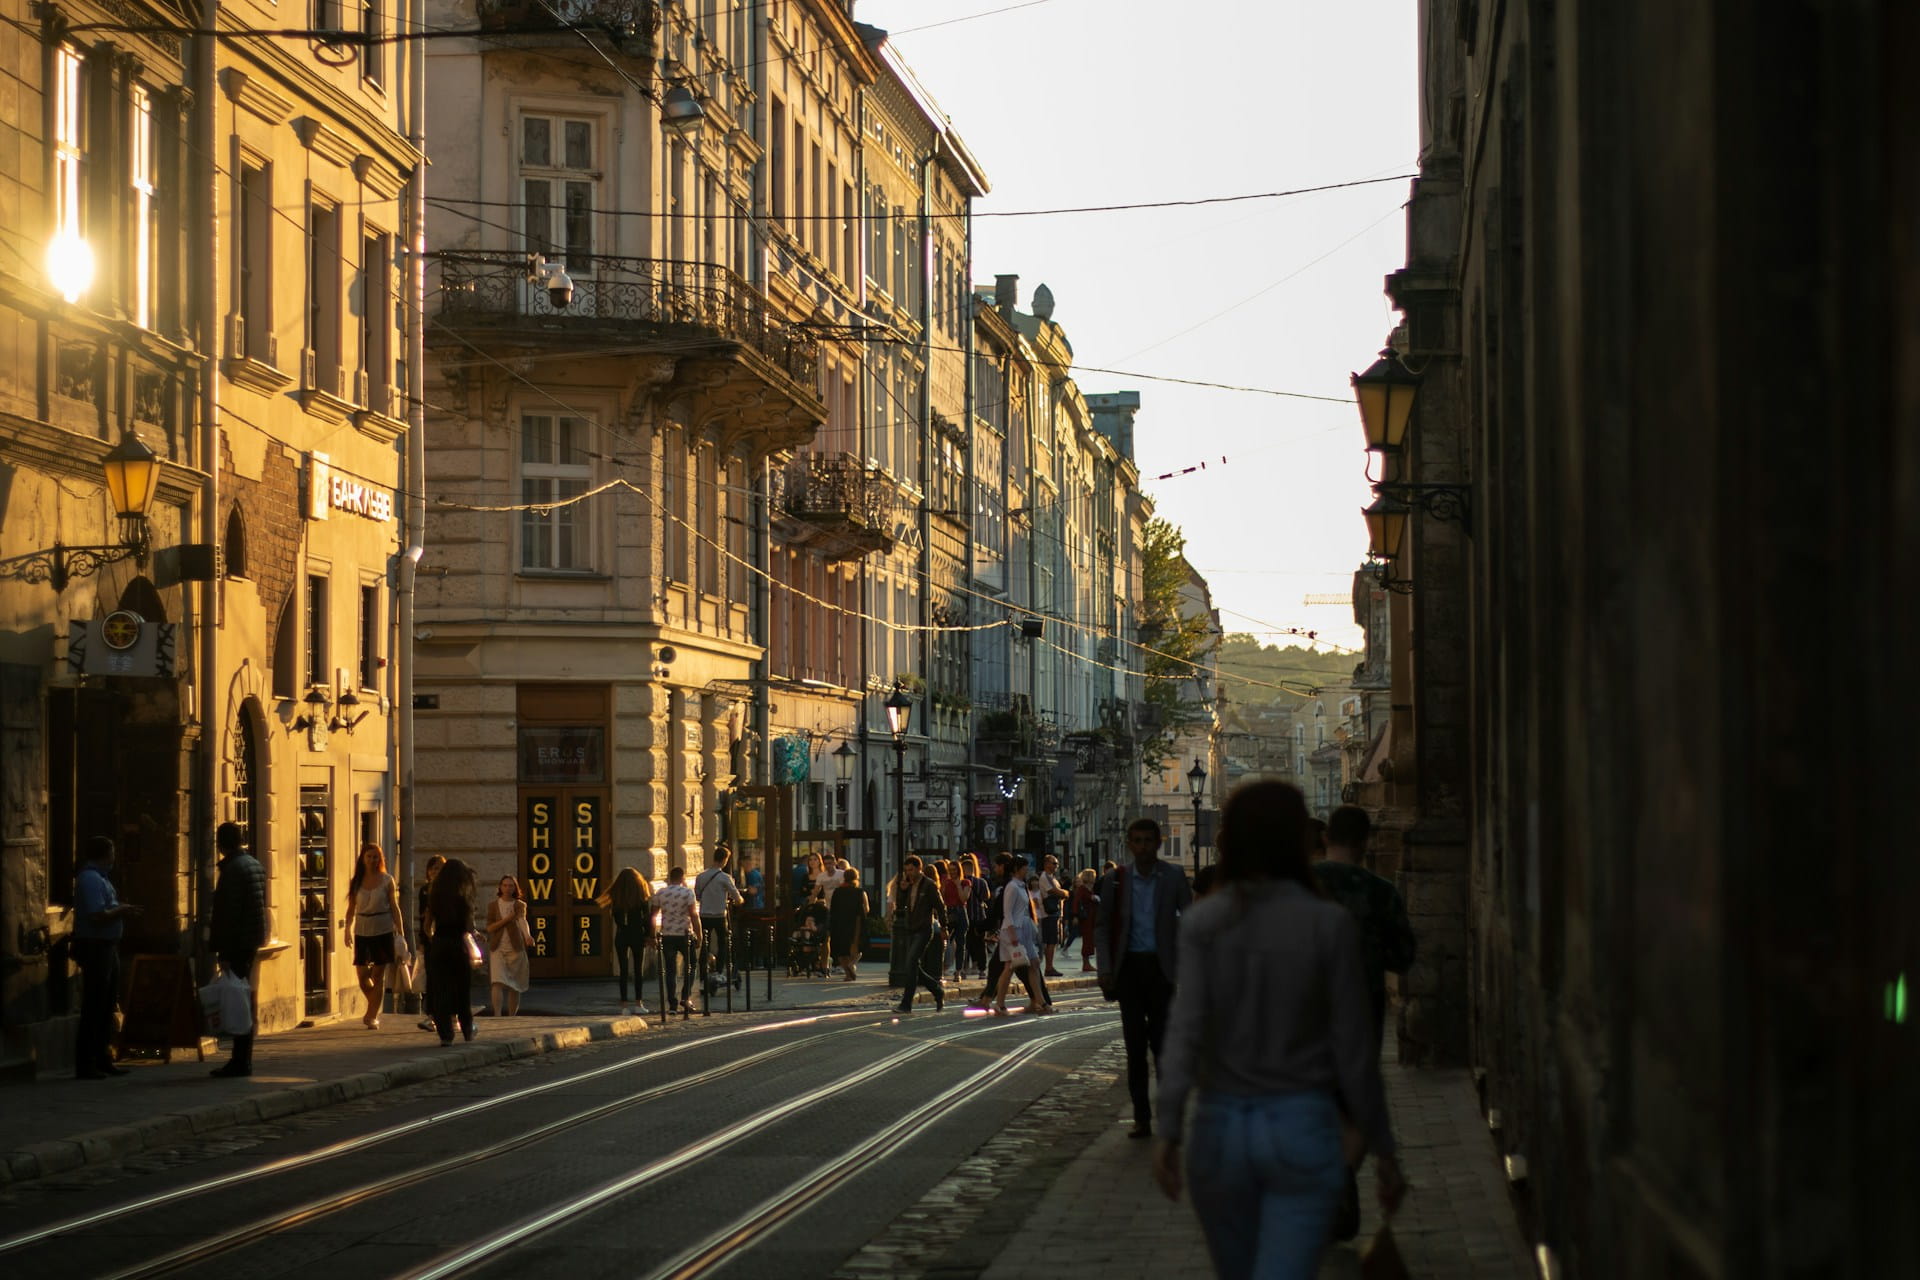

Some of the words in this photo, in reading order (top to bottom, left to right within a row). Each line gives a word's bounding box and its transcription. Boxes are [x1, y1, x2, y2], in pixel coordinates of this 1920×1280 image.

[528, 802, 554, 901] SHOW
[572, 802, 598, 901] SHOW
[535, 917, 547, 956] BAR
[580, 916, 591, 955] BAR
